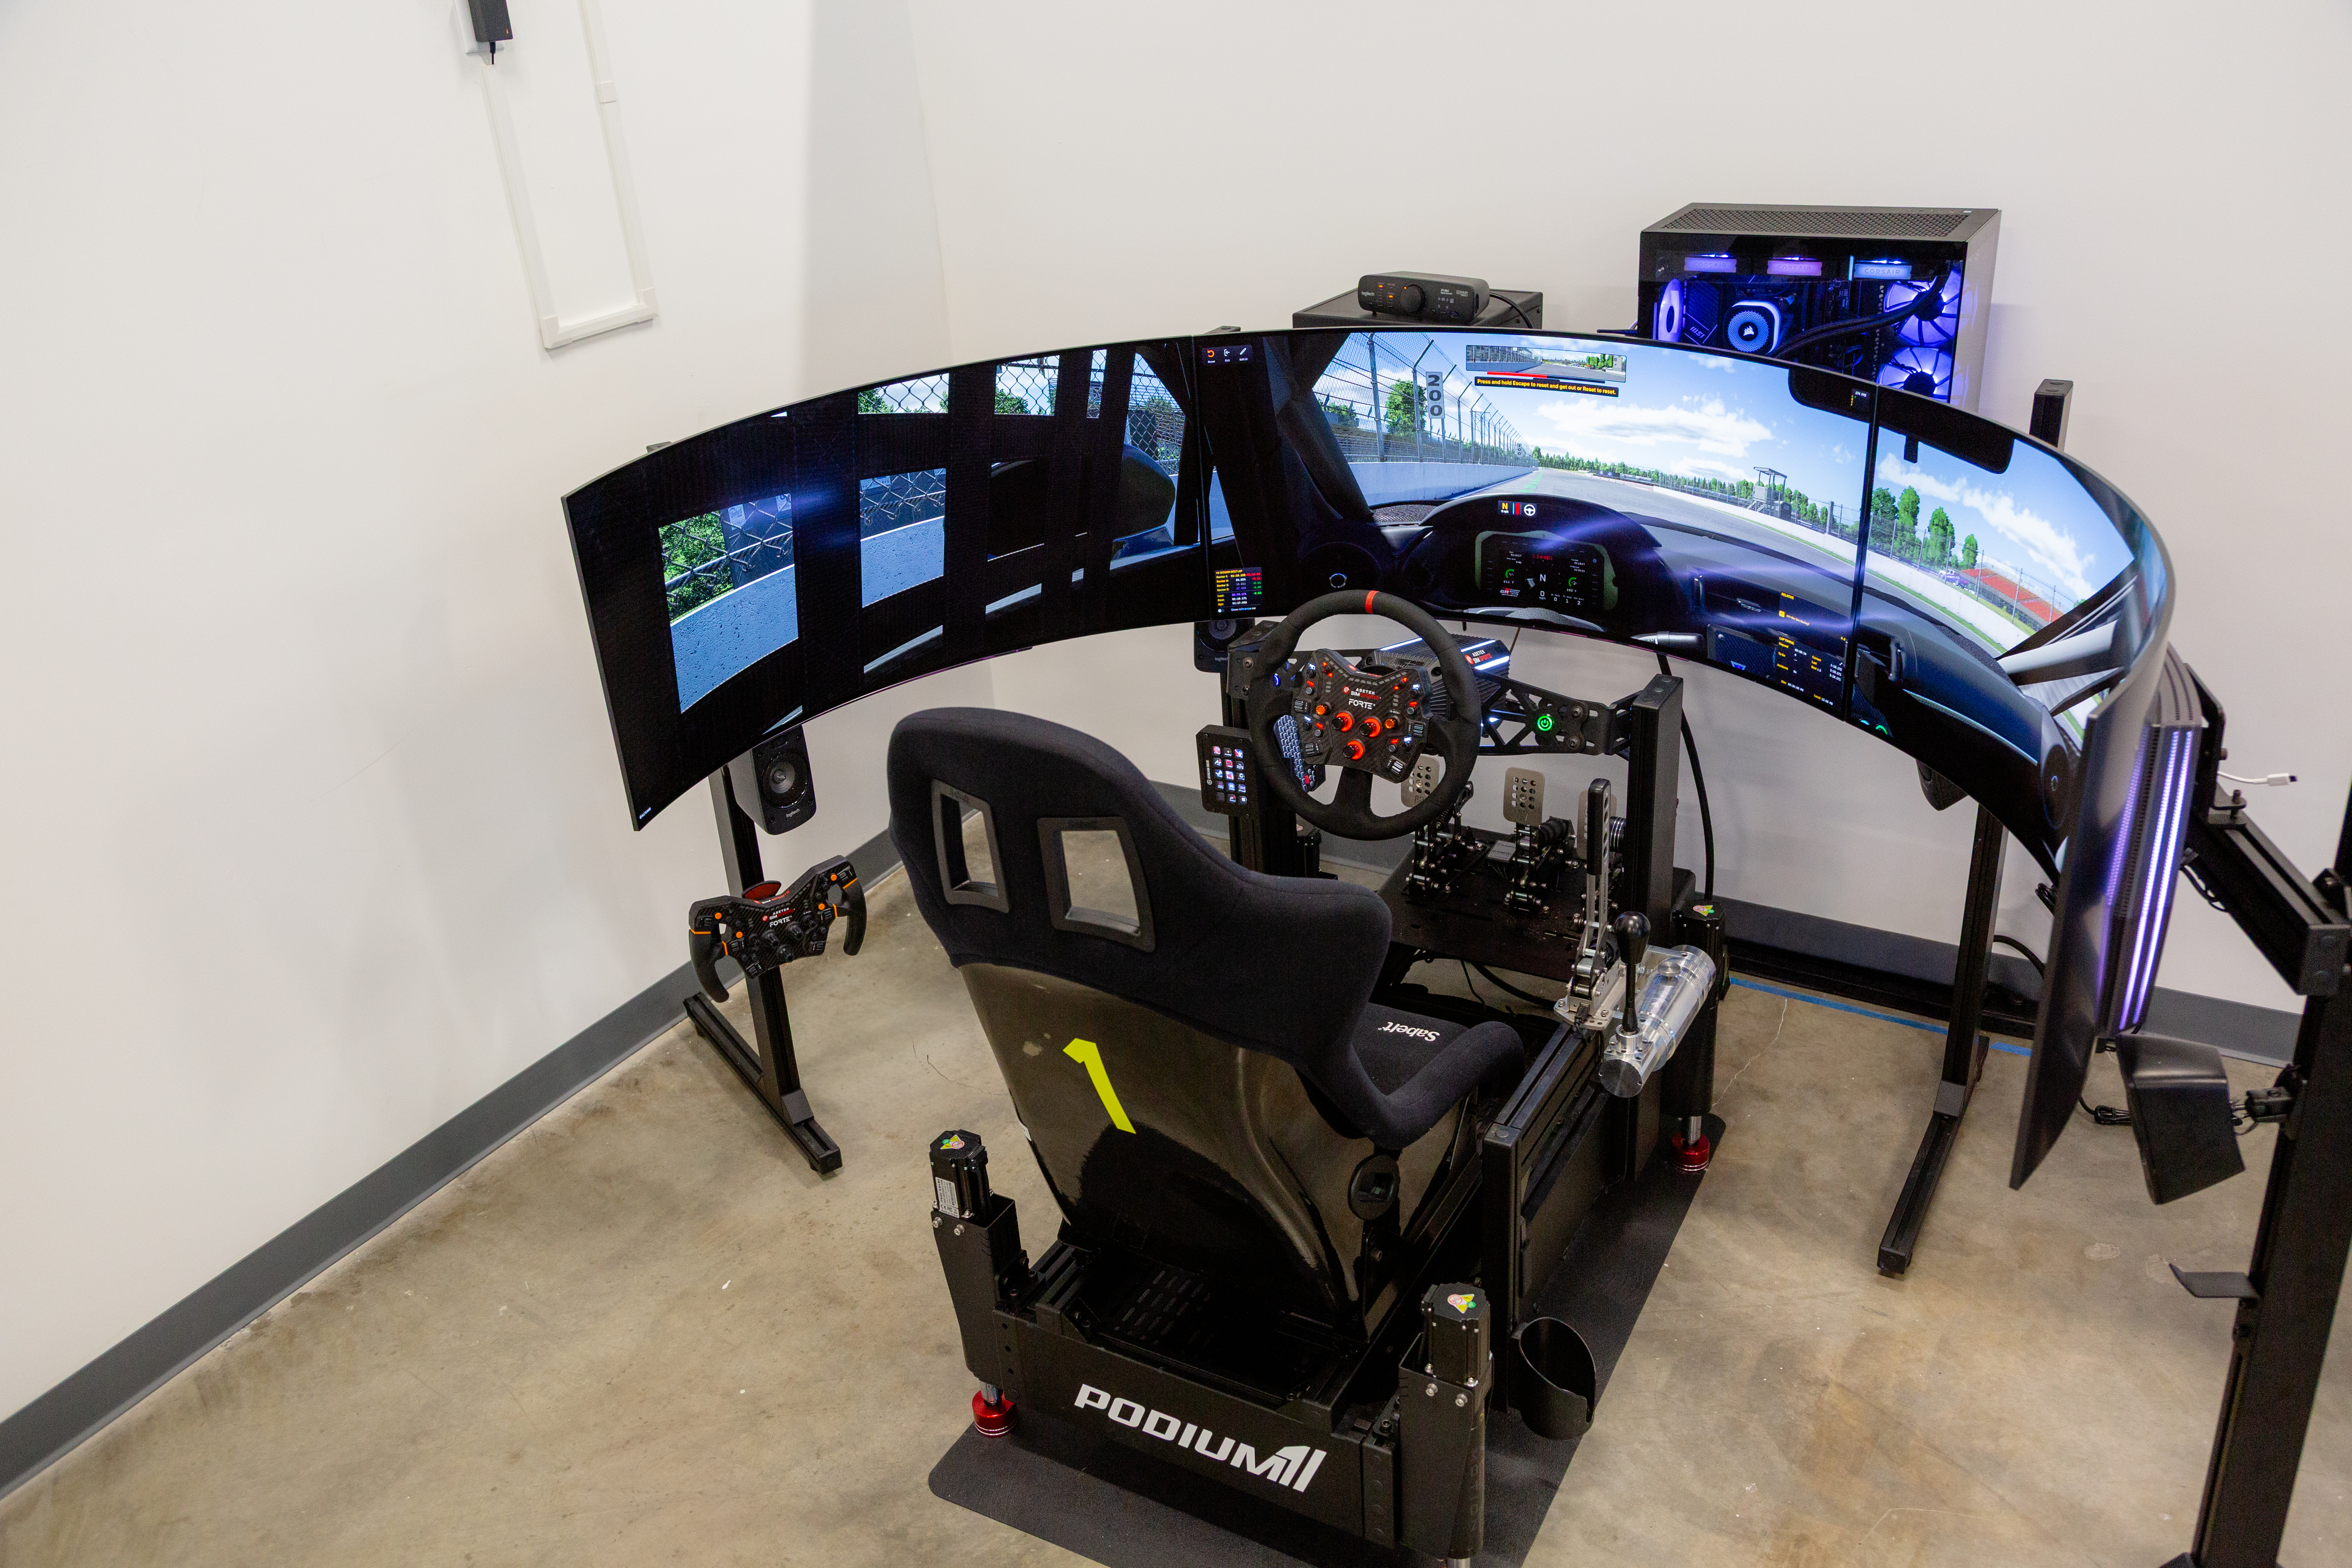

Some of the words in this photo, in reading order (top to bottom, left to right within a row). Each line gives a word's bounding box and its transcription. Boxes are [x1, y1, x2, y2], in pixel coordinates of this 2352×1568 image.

[1428, 374, 1443, 416] 200
[1539, 574, 1546, 582] N
[1348, 698, 1373, 710] FORTE
[786, 808, 800, 817] logitech
[769, 916, 791, 927] FORTE
[1382, 1022, 1440, 1042] Sabelt
